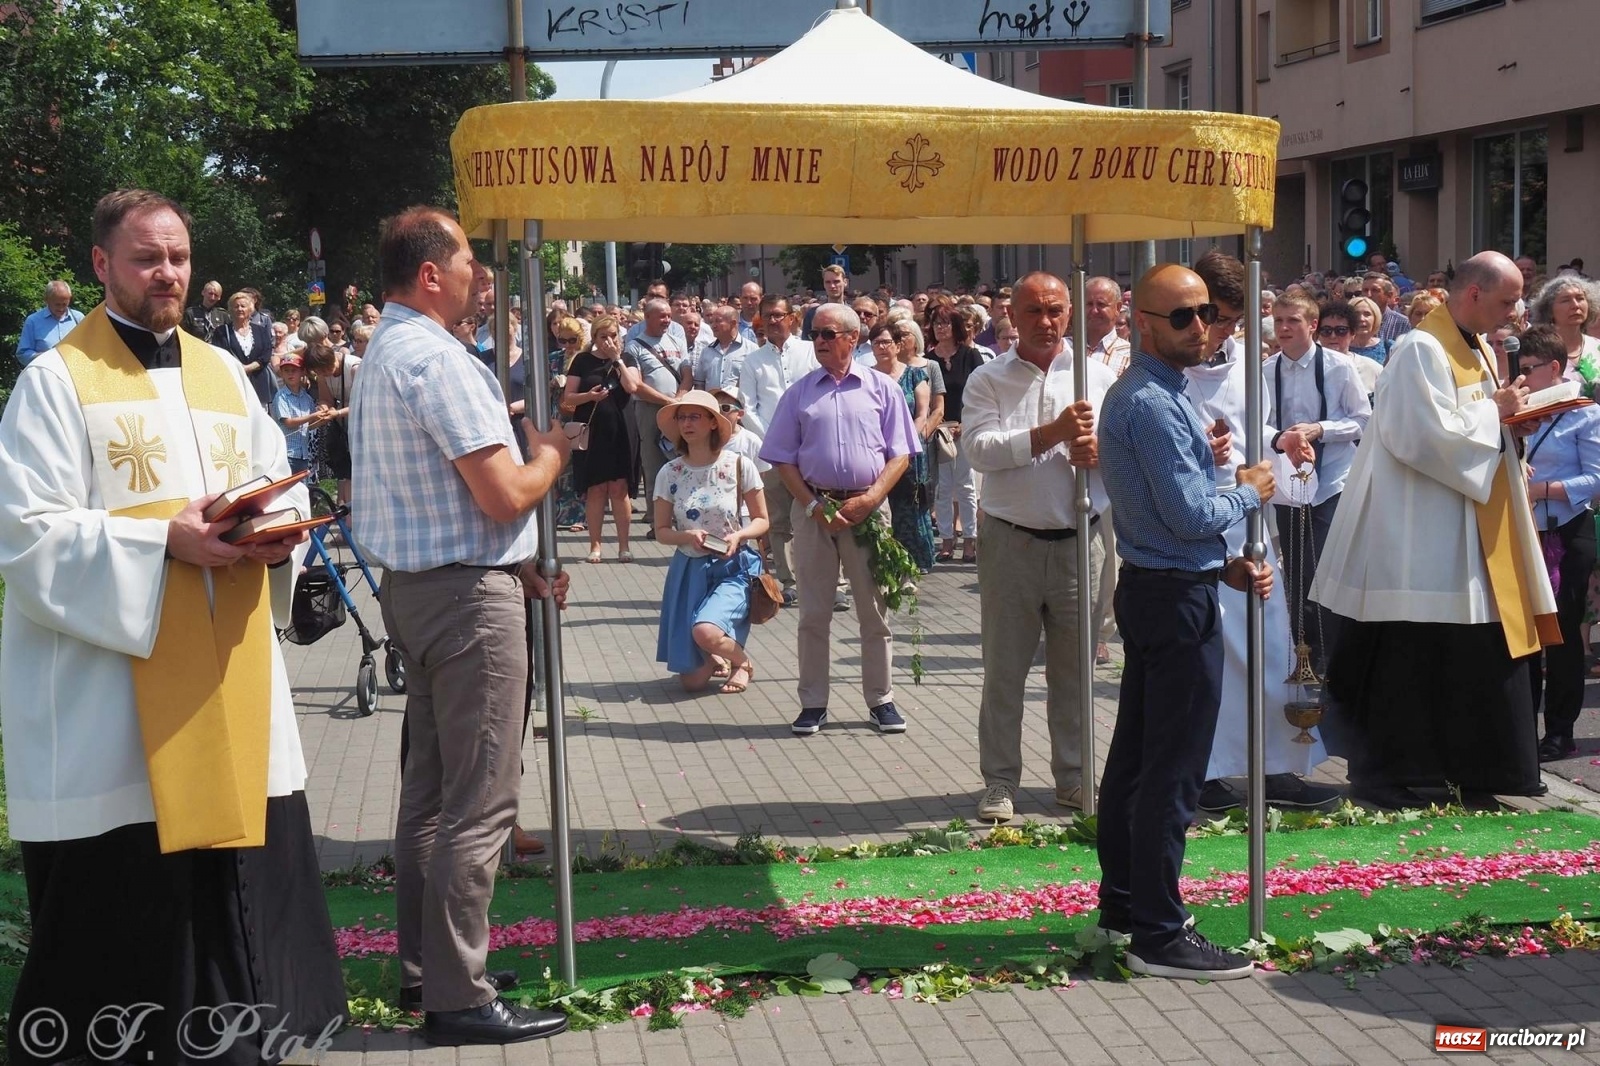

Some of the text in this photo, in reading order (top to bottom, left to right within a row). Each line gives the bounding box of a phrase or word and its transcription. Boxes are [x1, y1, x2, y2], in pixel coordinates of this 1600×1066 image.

[547, 1, 689, 41] KRYSTI
[640, 140, 730, 183] NAPÓJ
[751, 146, 822, 184] MNIE
[993, 147, 1058, 182] WODO
[1067, 147, 1084, 181] Z
[1090, 146, 1159, 181] BOKU
